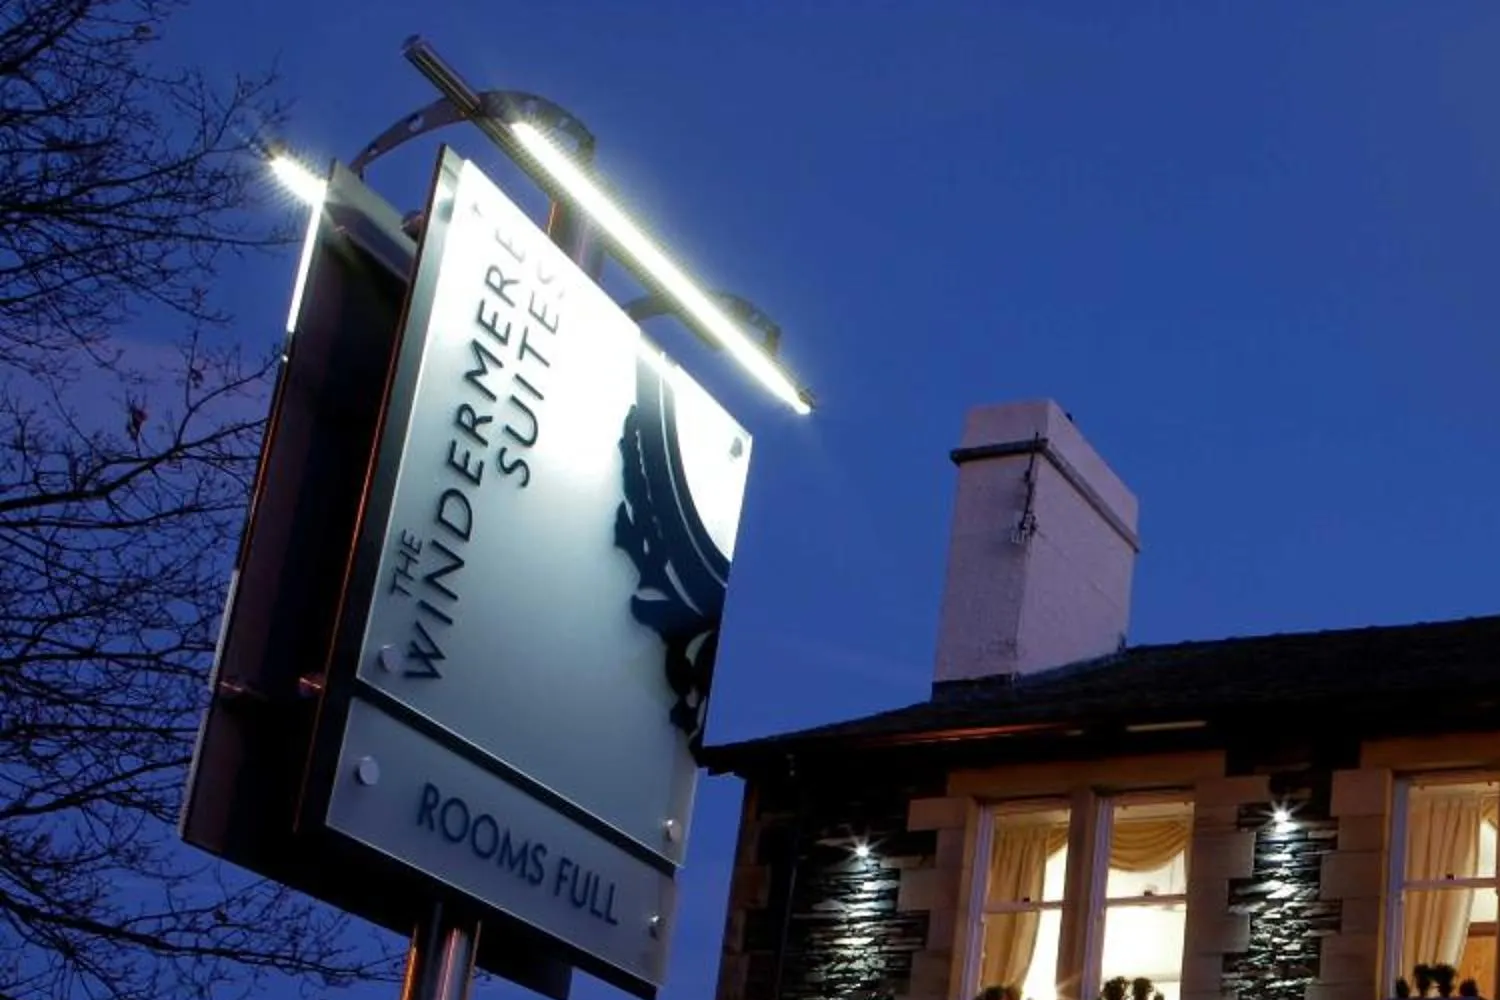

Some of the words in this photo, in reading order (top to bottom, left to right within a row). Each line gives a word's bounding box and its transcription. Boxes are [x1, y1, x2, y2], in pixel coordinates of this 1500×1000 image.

[403, 225, 526, 680] WINDERMERE
[390, 528, 422, 597] THE
[416, 782, 548, 886] ROOMS
[553, 857, 620, 927] FULL
